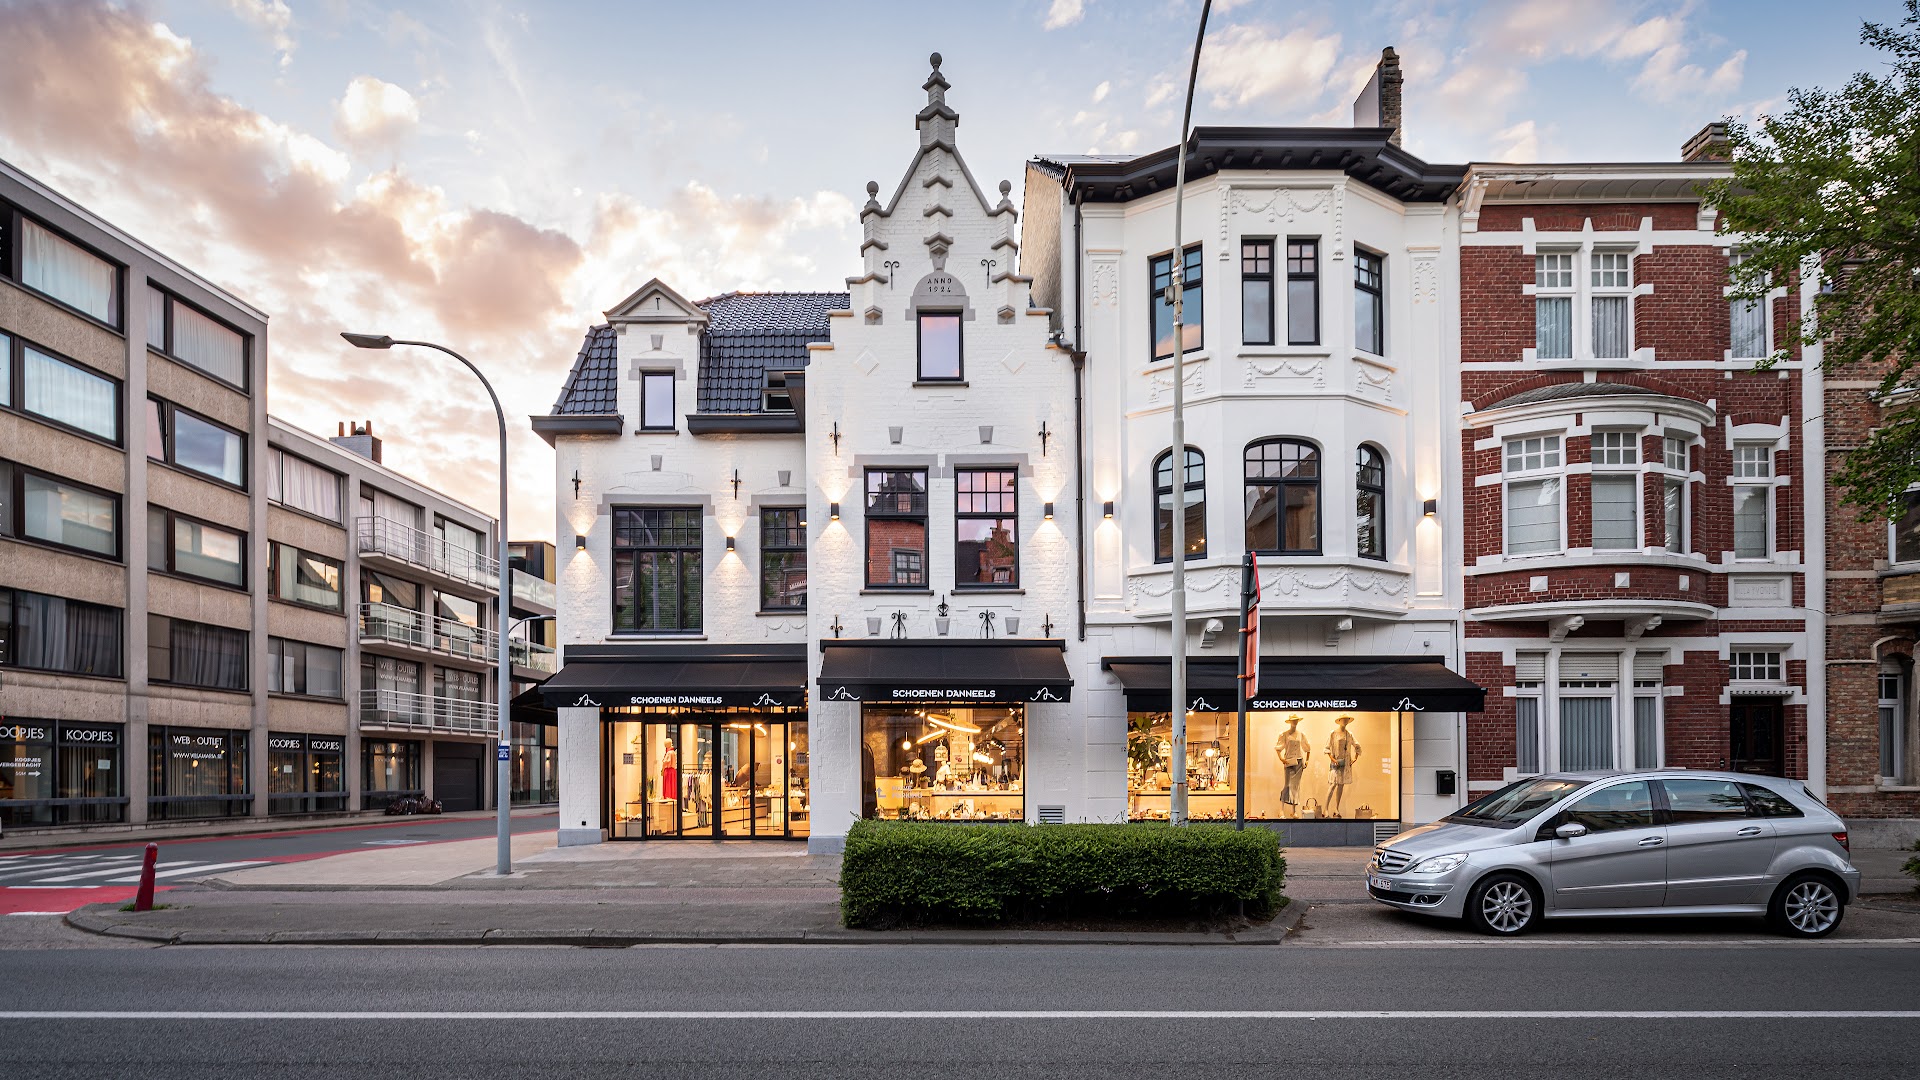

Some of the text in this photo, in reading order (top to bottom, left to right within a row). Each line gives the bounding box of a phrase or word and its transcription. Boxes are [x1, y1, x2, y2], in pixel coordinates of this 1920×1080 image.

[892, 689, 944, 698] SCHOENEN
[630, 696, 677, 704] SCHOENEN
[1252, 700, 1305, 708] SCHOENEN
[0, 726, 44, 740] OOPJES
[66, 729, 114, 742] KOOPJES
[172, 735, 191, 745] WEB
[196, 736, 223, 746] OUTLET
[269, 738, 300, 749] KOOPJES
[311, 740, 340, 750] KOOPJES
